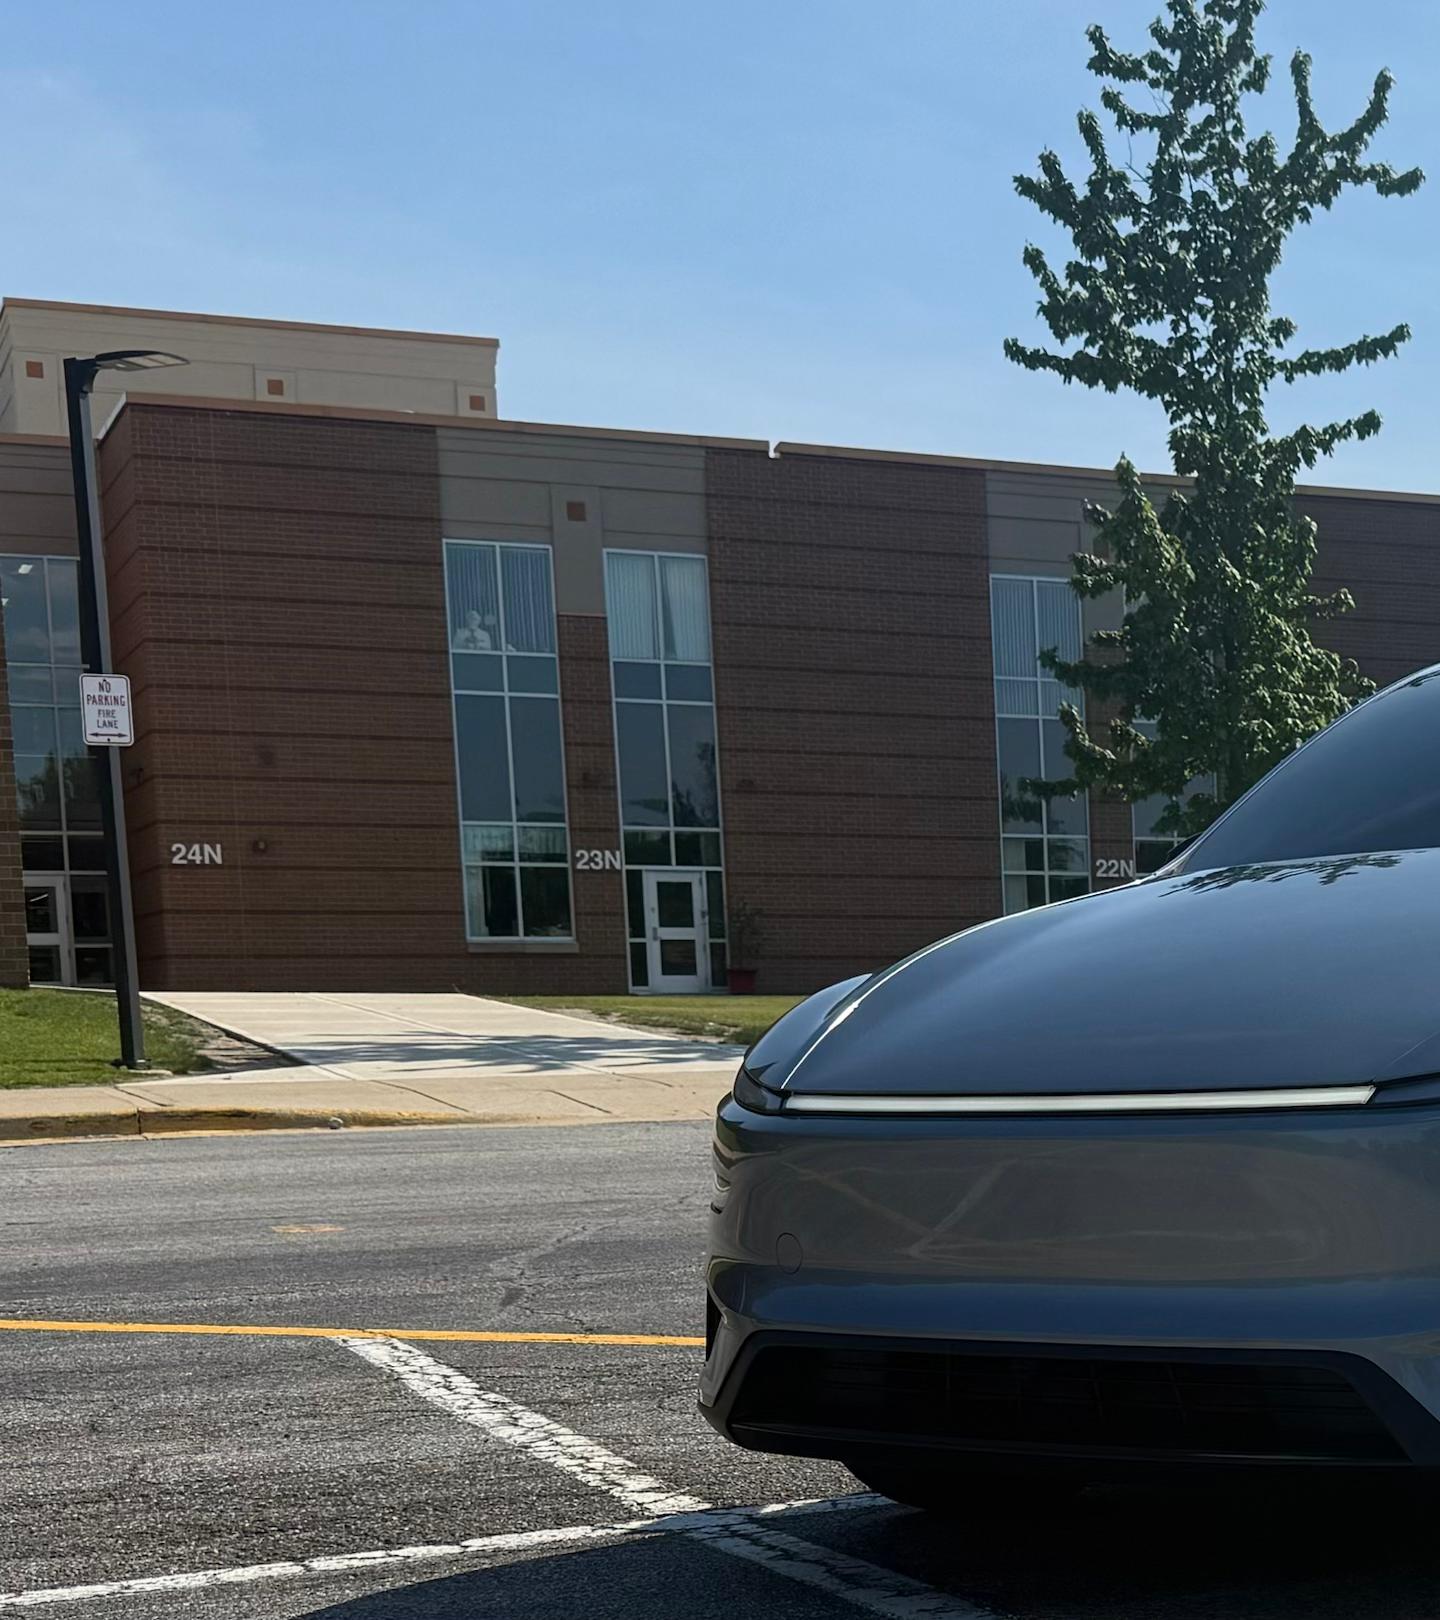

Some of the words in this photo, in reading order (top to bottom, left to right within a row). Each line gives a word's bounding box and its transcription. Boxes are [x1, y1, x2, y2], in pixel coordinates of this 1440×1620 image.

[98, 681, 111, 693] NO
[86, 694, 125, 706] PARKING
[97, 708, 116, 718] FIRE
[96, 719, 119, 729] LANE
[171, 843, 223, 865] 24N
[575, 849, 621, 870] 23N
[1095, 858, 1134, 877] 22N
